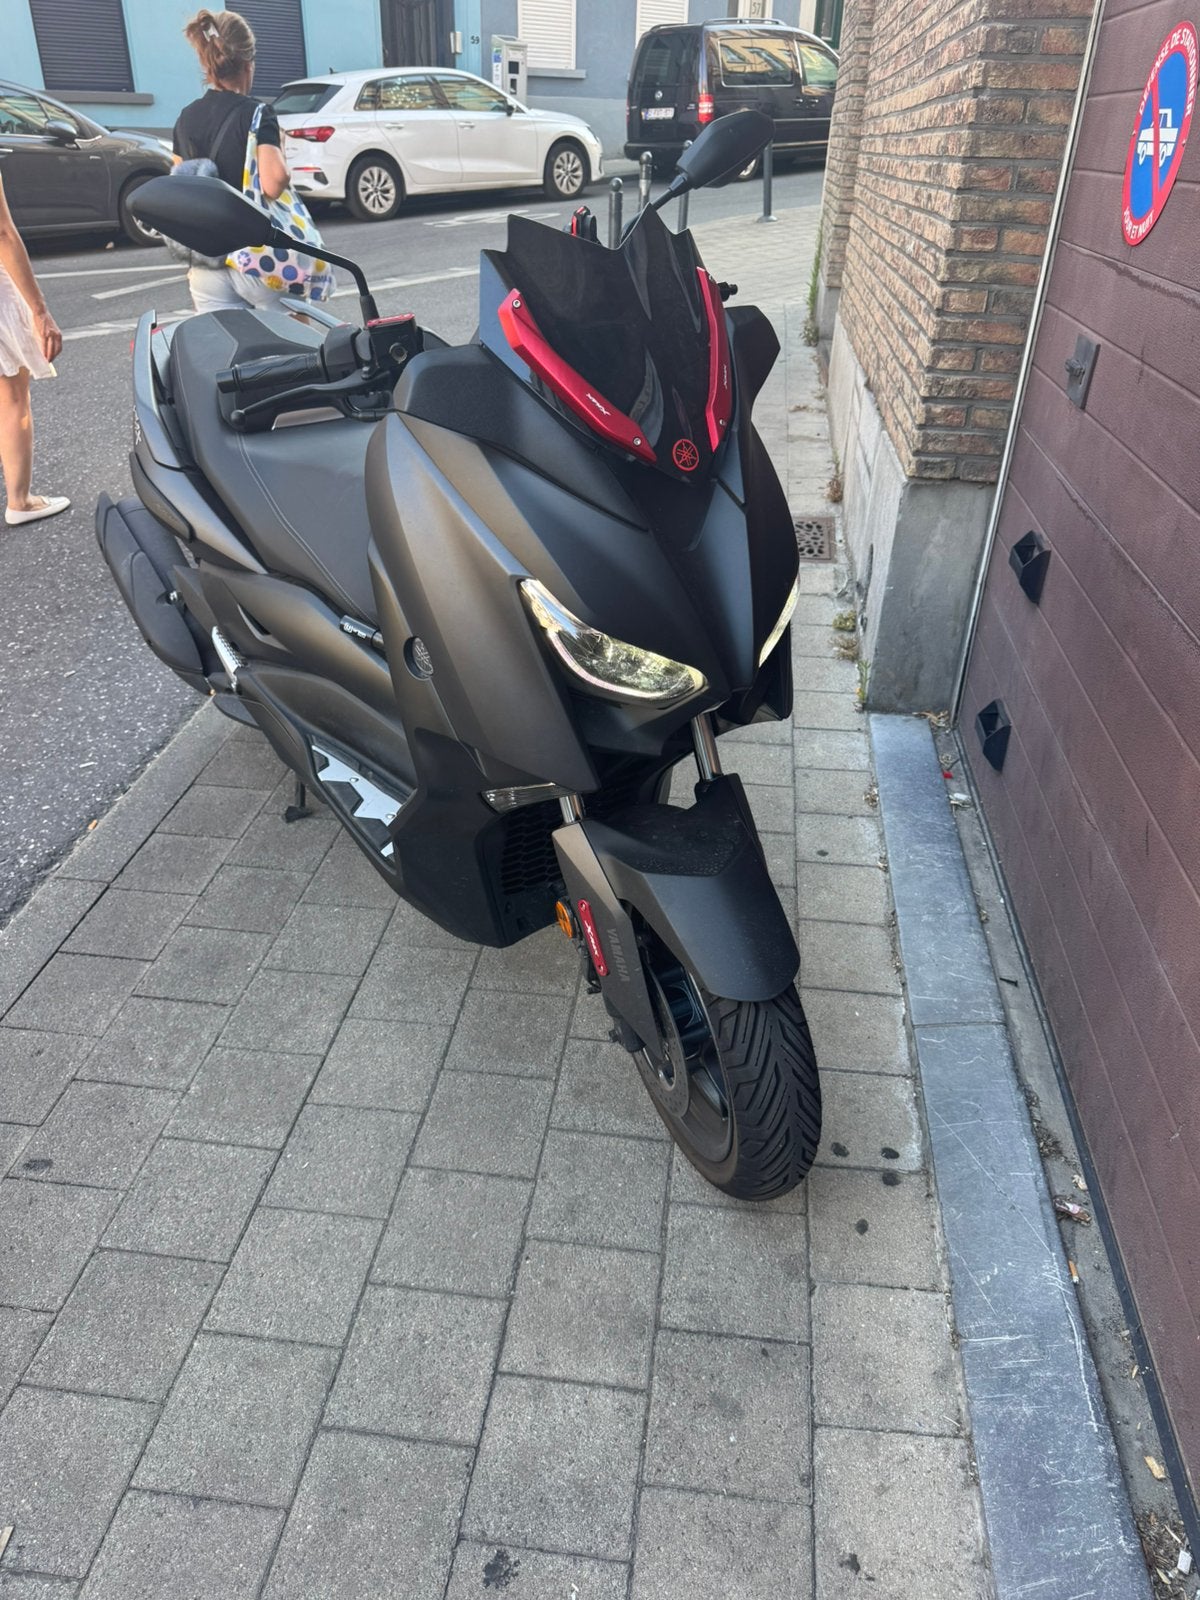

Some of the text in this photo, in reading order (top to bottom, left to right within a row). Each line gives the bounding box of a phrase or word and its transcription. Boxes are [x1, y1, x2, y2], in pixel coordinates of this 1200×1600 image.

[752, 2, 761, 15] 57
[1139, 28, 1196, 116] DEFENSE DE STATIONNER
[607, 928, 630, 981] YAMAHA
